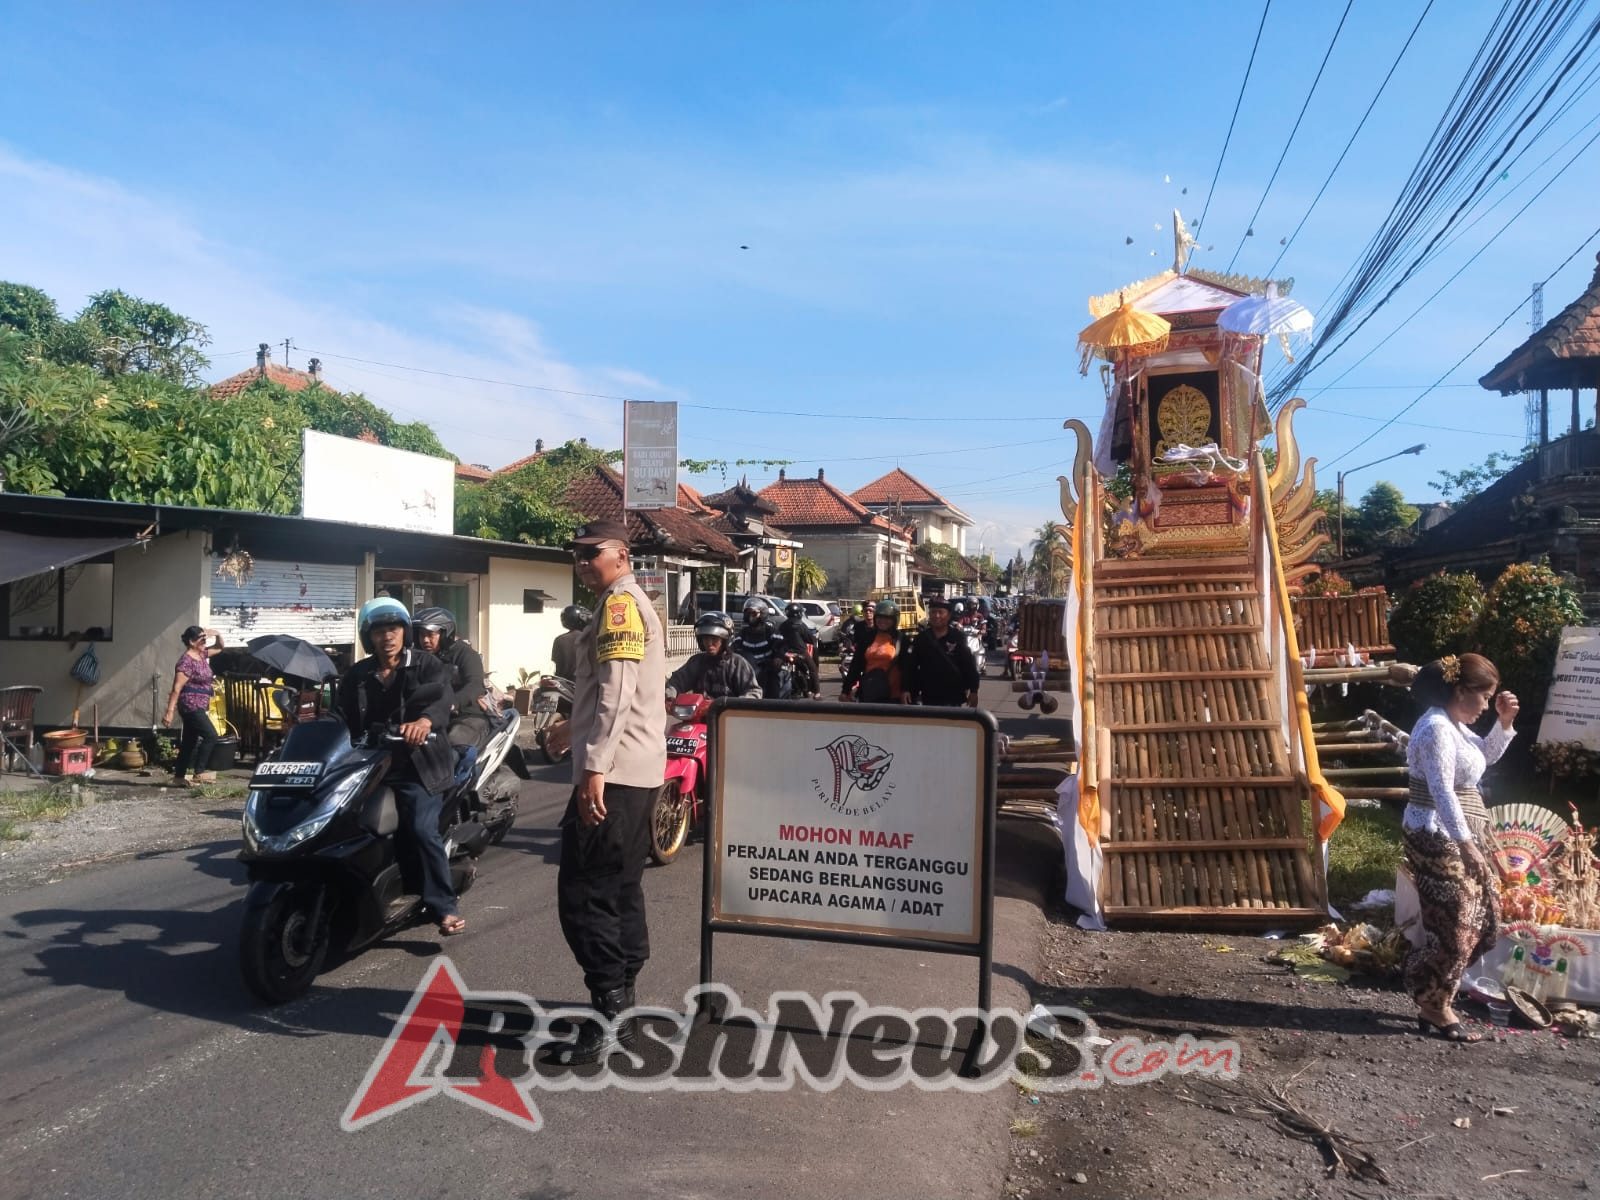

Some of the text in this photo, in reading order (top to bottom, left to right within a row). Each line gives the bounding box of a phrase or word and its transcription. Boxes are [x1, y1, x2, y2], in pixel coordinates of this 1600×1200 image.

[811, 778, 896, 816] PURI GEDE BELAYU
[779, 824, 914, 850] MOHON MAAF
[727, 844, 968, 876] PERJALAN ANDA TERGANGGU
[749, 866, 944, 895] SEDANG BERLANGSUNG
[748, 887, 944, 917] UPACARA AGAMA / ADAT
